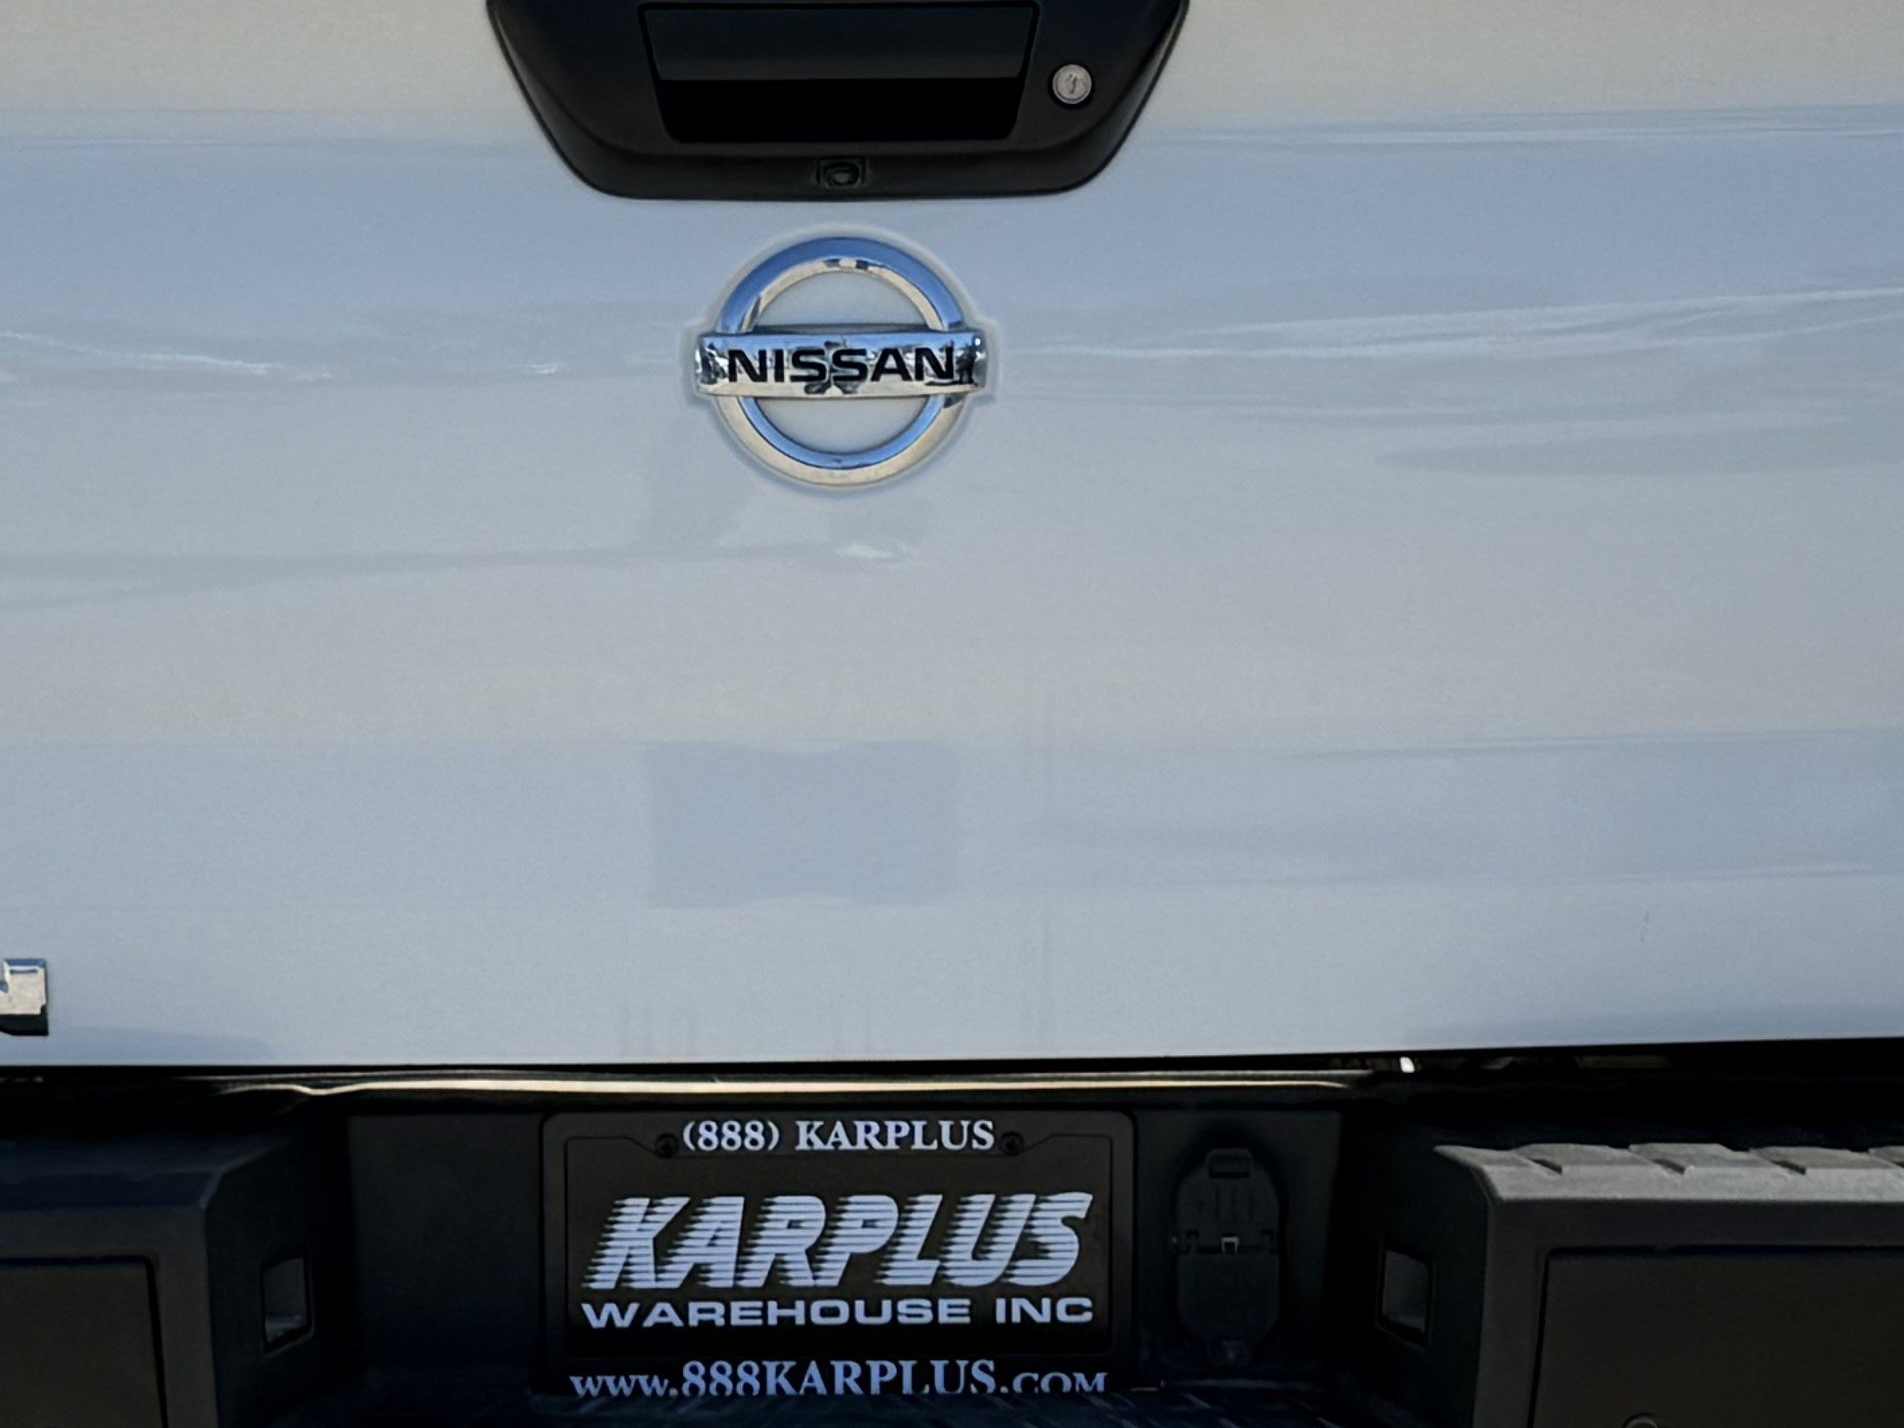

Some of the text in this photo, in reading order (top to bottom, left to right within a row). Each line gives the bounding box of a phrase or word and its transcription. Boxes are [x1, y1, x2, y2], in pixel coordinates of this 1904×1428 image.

[727, 347, 955, 383] NISSAN
[682, 1120, 994, 1152] (888) KARPLUS
[580, 1192, 1094, 1290] KARPLUS
[580, 1297, 1094, 1329] WAREHOUSE INC
